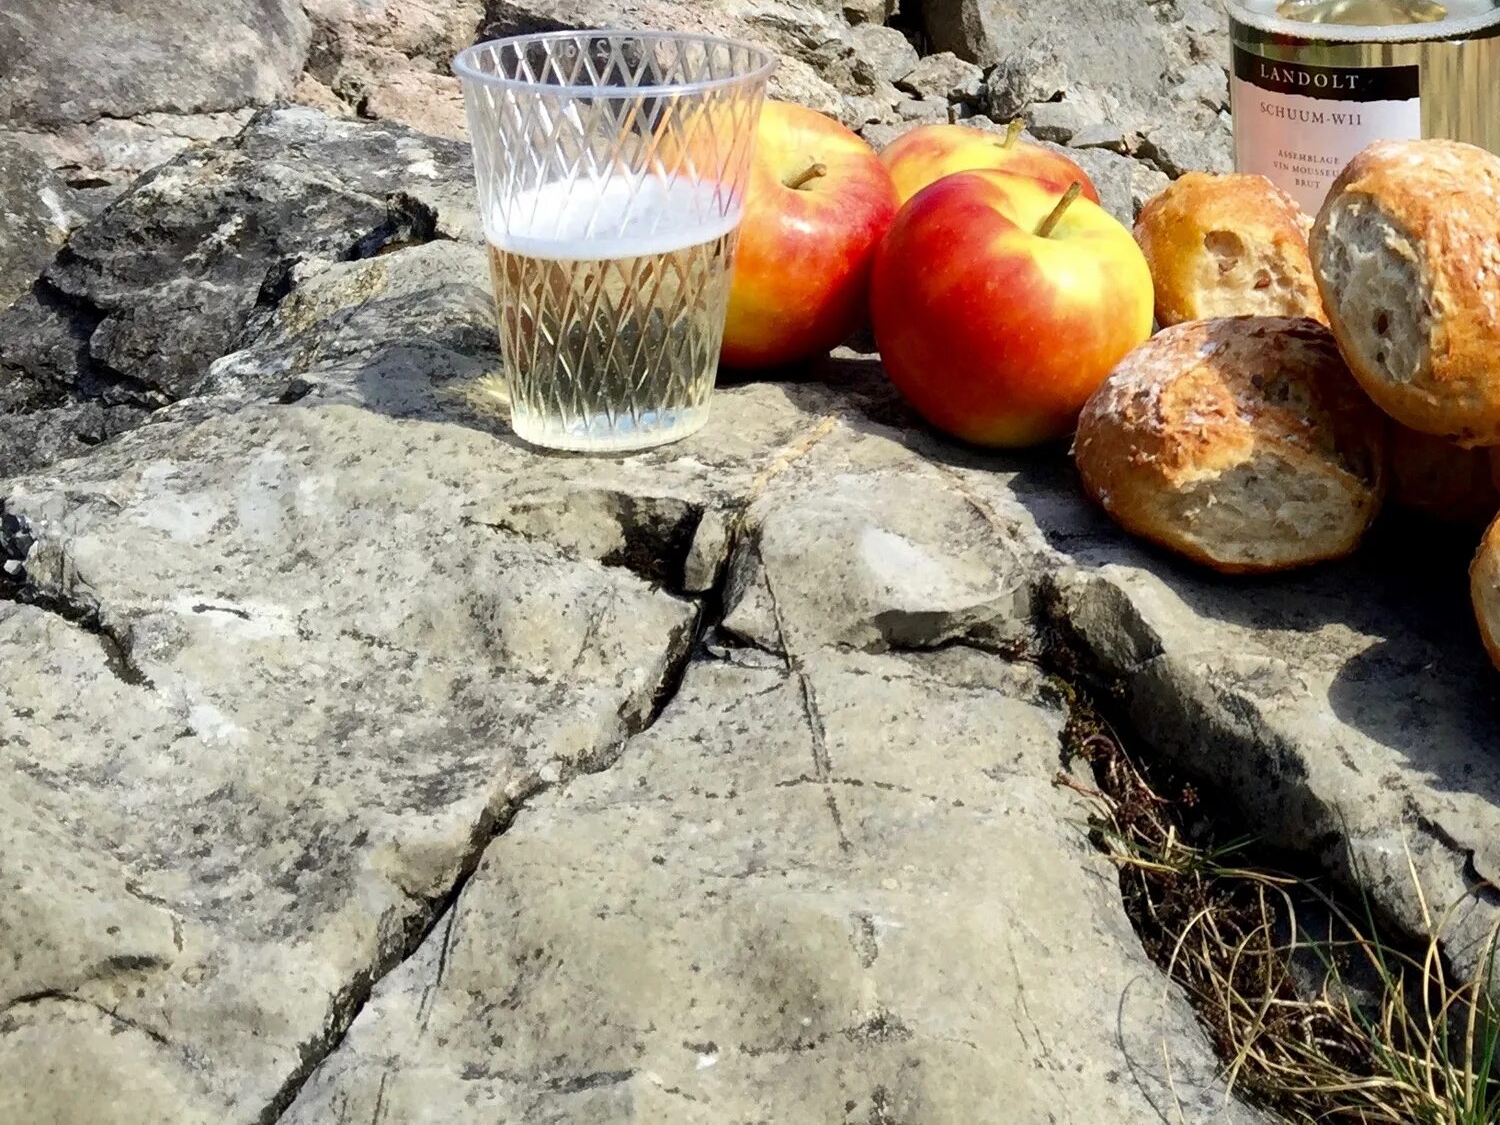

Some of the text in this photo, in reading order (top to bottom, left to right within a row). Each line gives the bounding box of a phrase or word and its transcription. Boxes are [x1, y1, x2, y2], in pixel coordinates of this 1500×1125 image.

[1260, 64, 1359, 89] LANDOLT
[1260, 102, 1362, 125] SCHUUM-WII
[1278, 150, 1340, 164] ASSEMBLAGE
[1273, 160, 1340, 178] VIN MOUSSEU
[1295, 178, 1321, 190] BRUT
